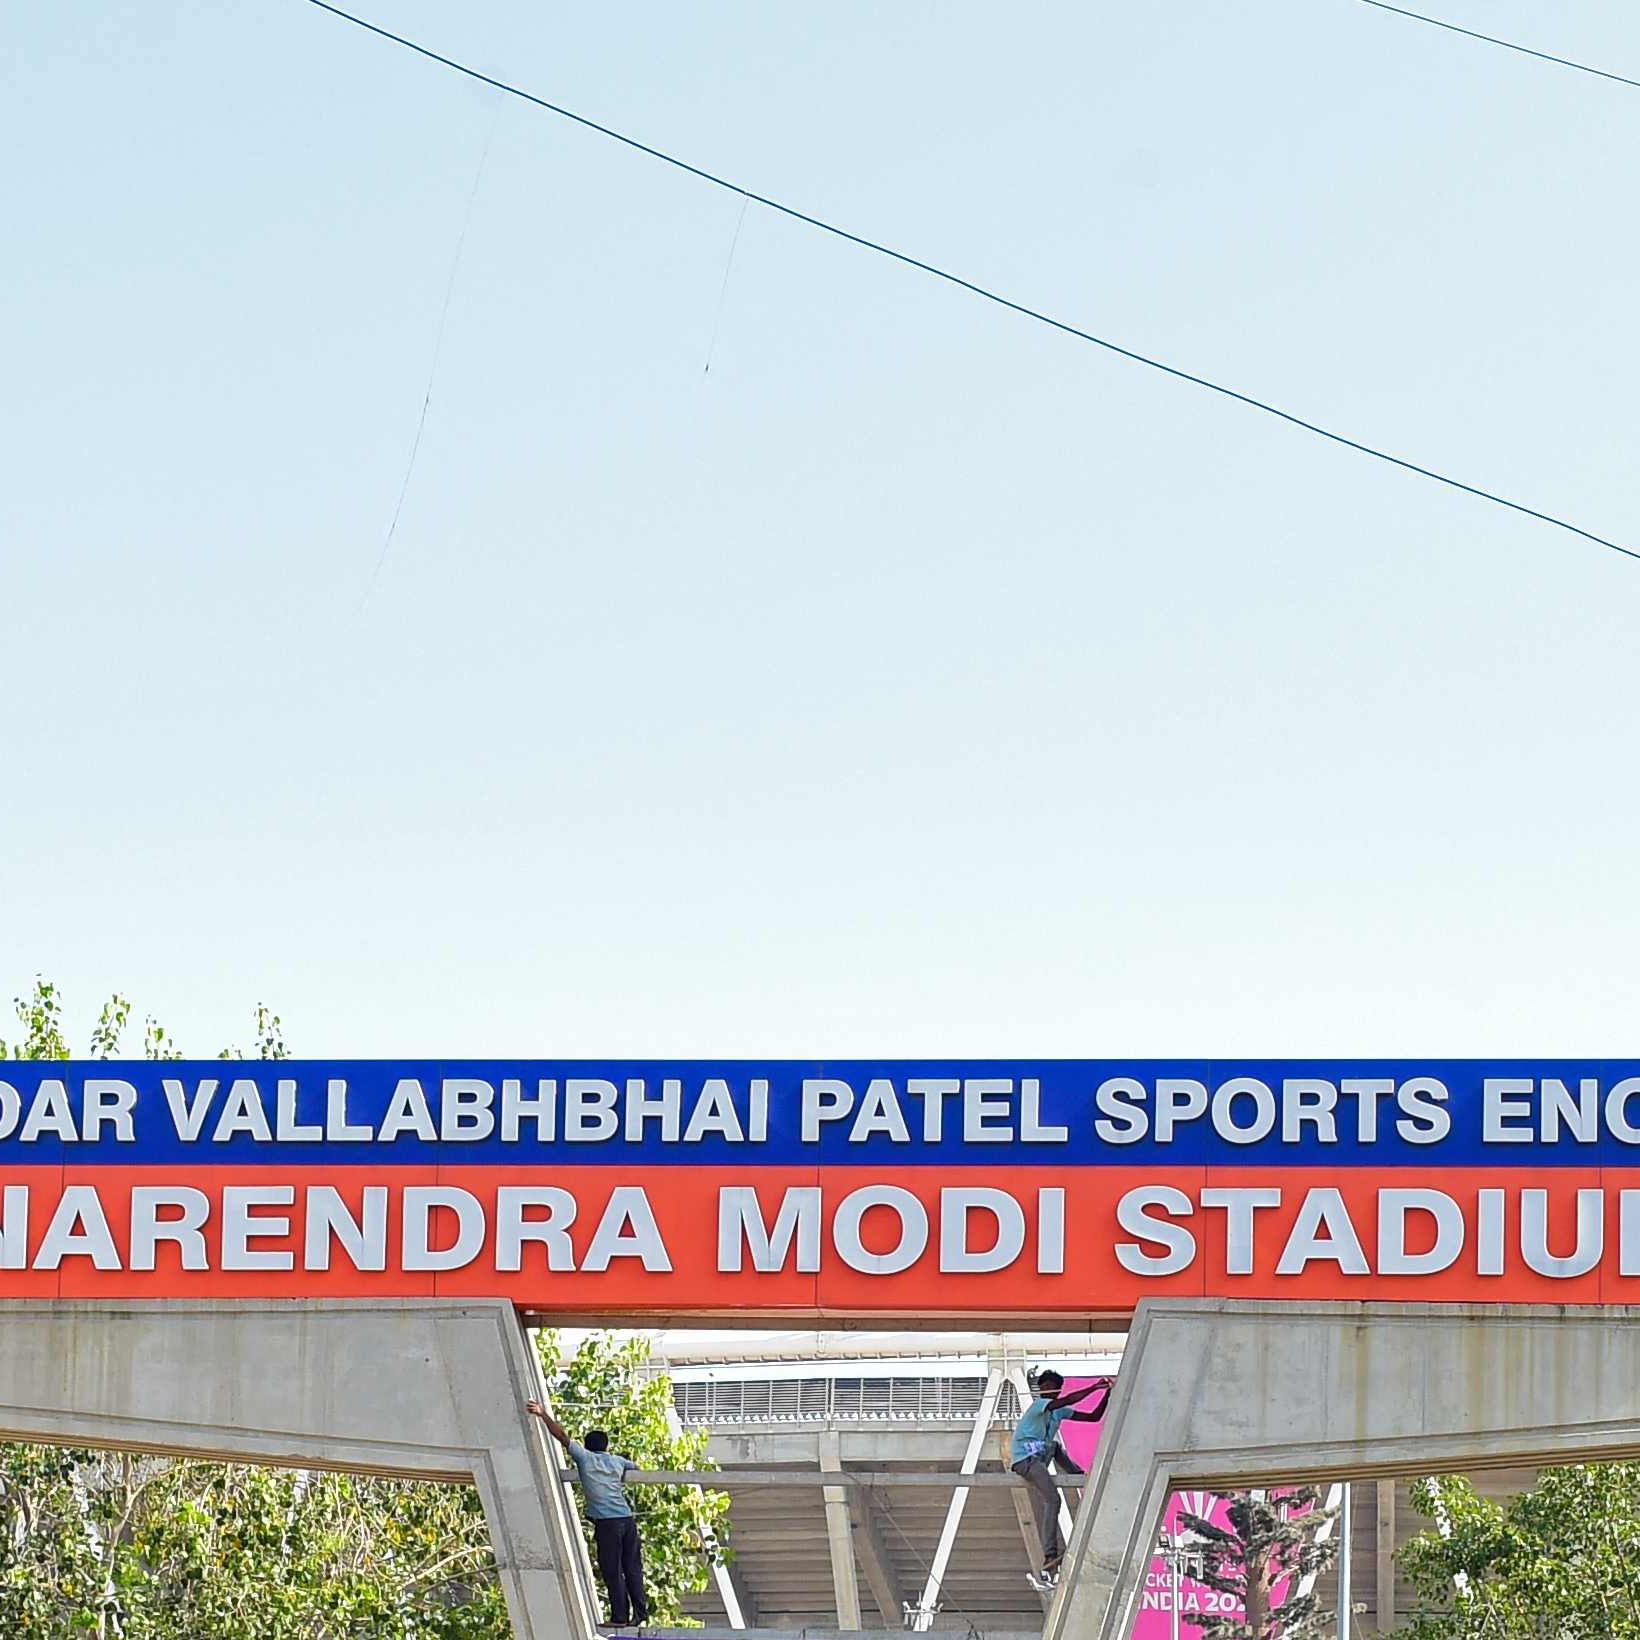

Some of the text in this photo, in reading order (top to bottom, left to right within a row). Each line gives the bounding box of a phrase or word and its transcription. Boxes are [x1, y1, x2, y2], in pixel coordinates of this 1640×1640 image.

[161, 1077, 770, 1143] VALLABHBHAI
[800, 1078, 1069, 1143] PATEL
[1094, 1076, 1452, 1145] SPORTS
[716, 1183, 1066, 1276] MODI
[1139, 1591, 1201, 1611] NDIA
